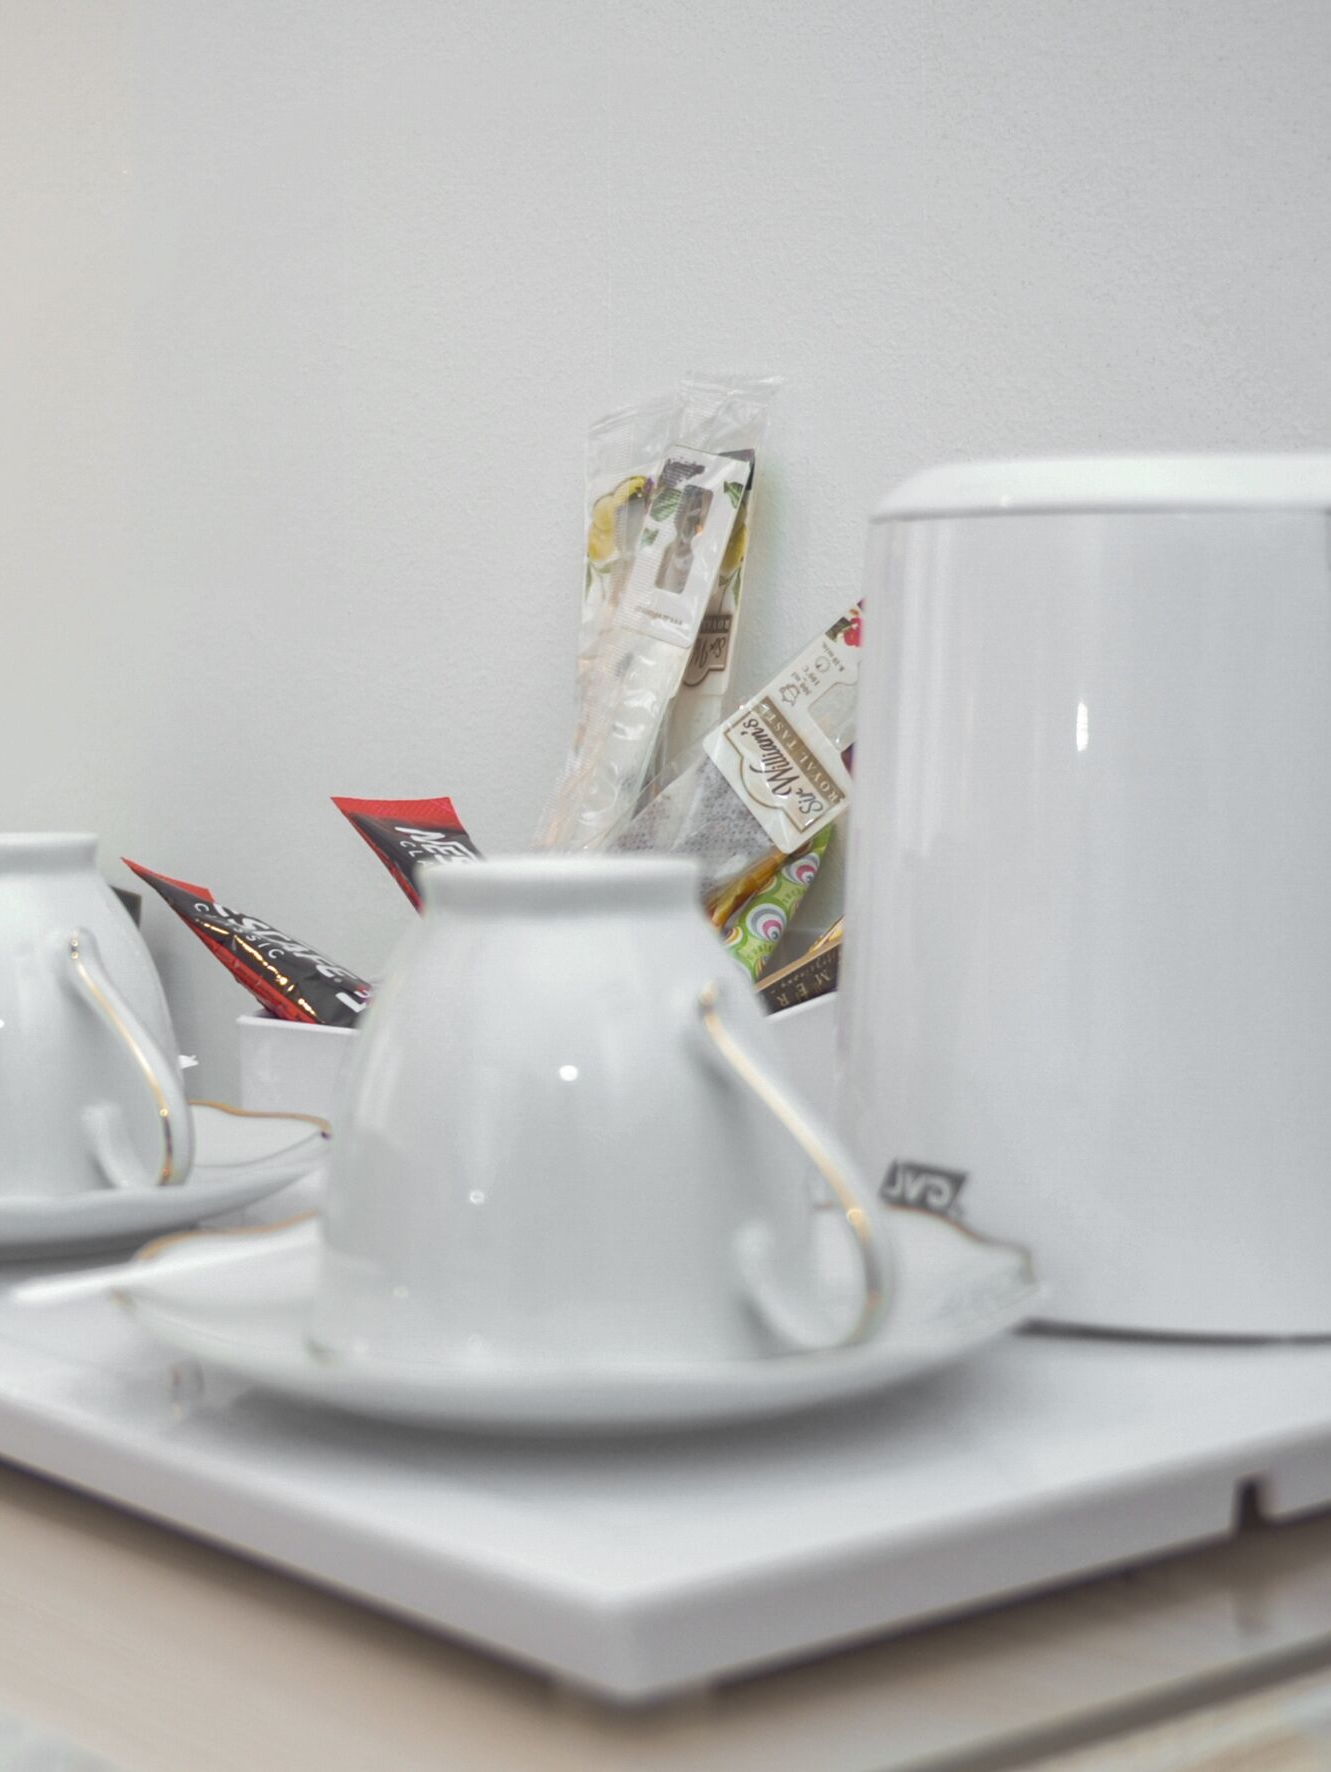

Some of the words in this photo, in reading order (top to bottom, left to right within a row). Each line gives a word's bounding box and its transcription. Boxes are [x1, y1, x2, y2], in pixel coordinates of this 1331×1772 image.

[741, 718, 800, 797] William's
[800, 753, 839, 803] ROYAL
[794, 786, 824, 815] Sir
